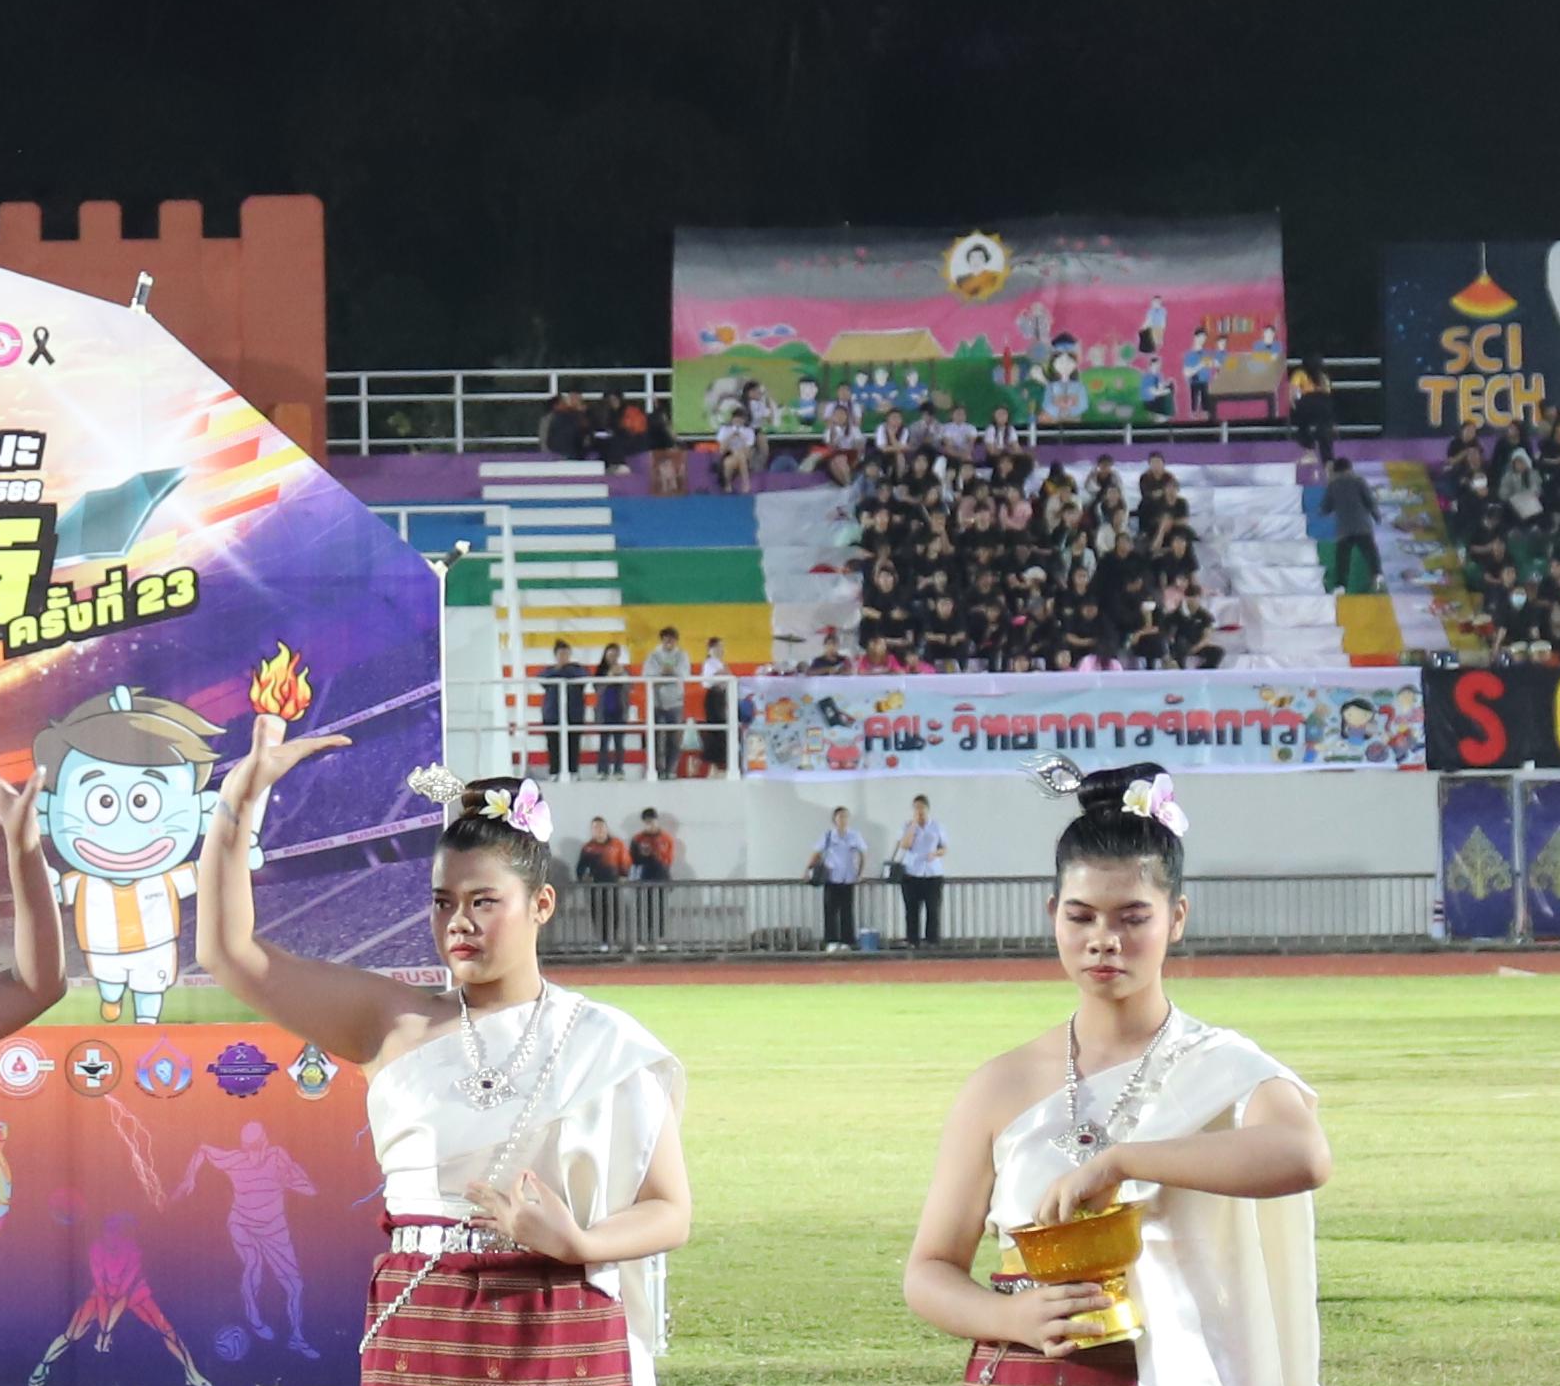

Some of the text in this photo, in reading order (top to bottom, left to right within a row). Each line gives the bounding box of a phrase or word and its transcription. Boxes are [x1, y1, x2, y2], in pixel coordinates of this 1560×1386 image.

[1441, 323, 1522, 373] SCI
[1418, 373, 1545, 428] TECH
[8, 568, 196, 650] ครั้งที่ 23
[157, 969, 167, 984] 9
